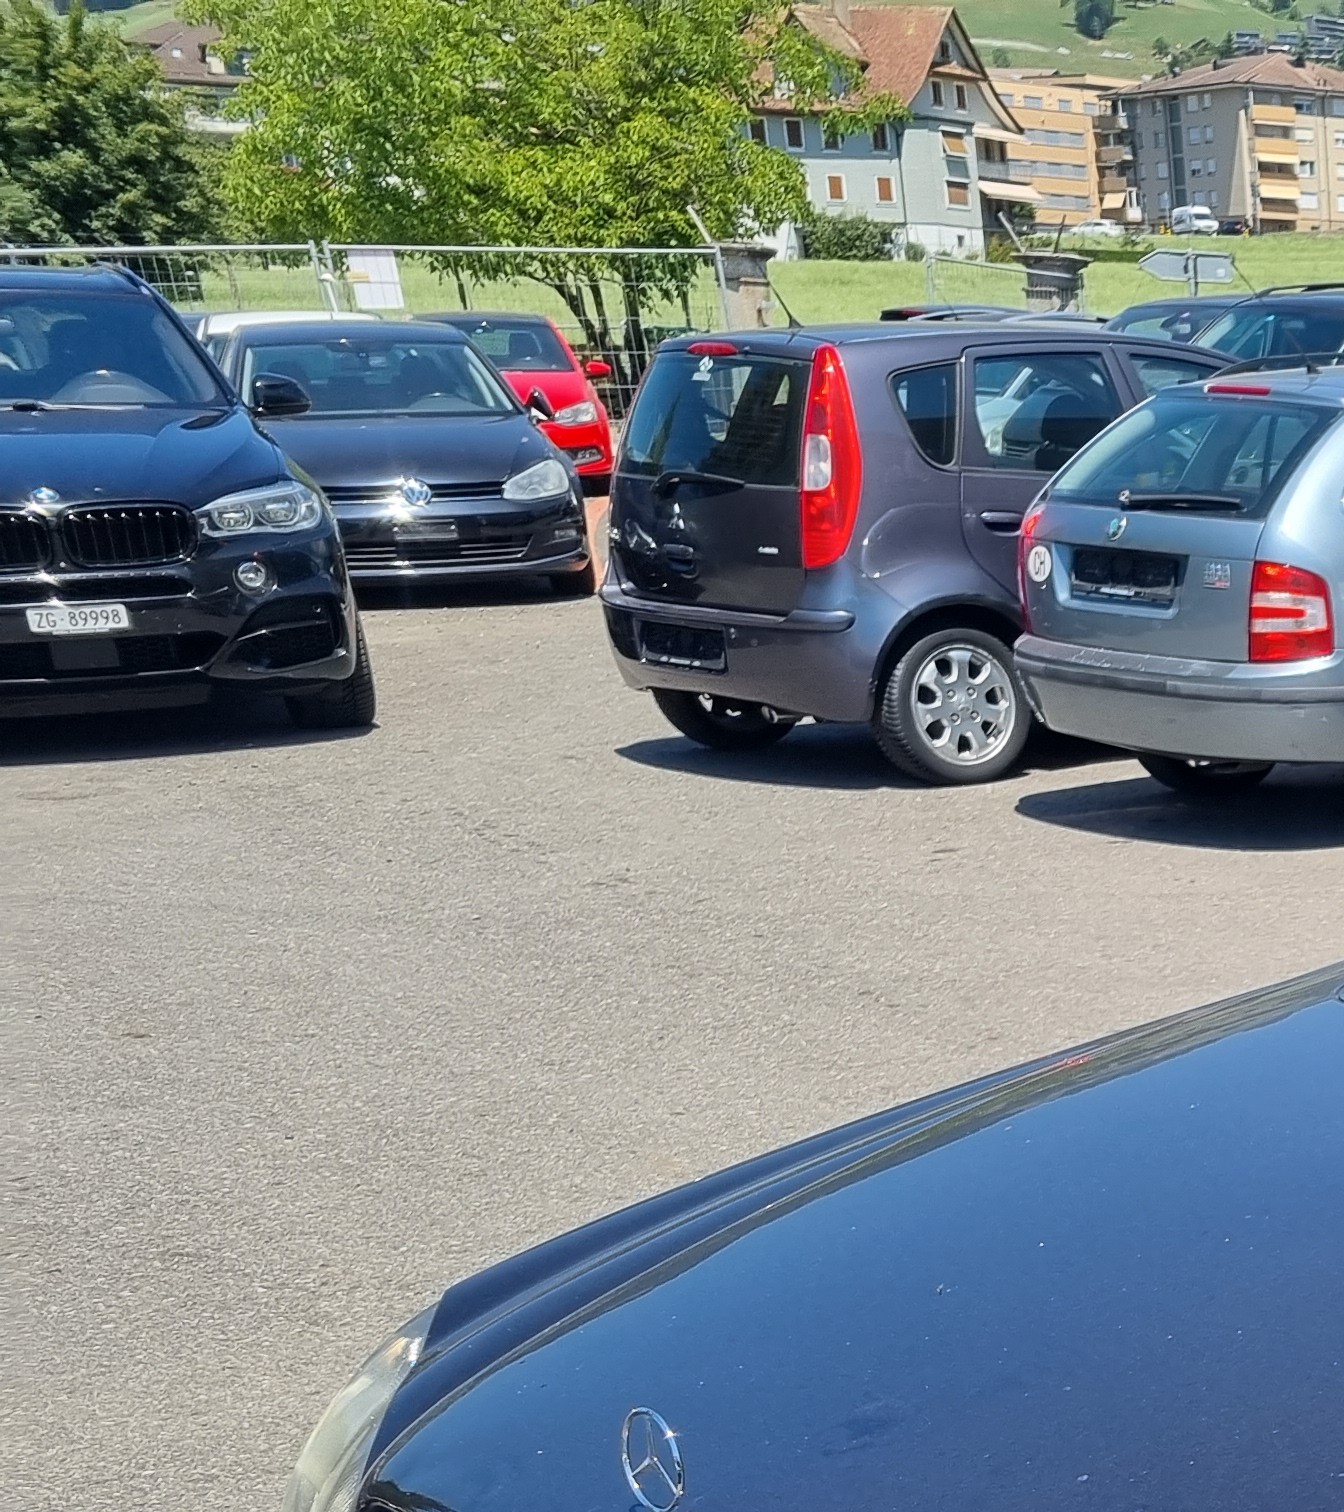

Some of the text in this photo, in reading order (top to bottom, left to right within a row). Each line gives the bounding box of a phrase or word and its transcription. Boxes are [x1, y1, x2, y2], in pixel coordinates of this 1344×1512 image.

[1033, 551, 1046, 577] CH
[33, 609, 122, 629] ZG 89998
